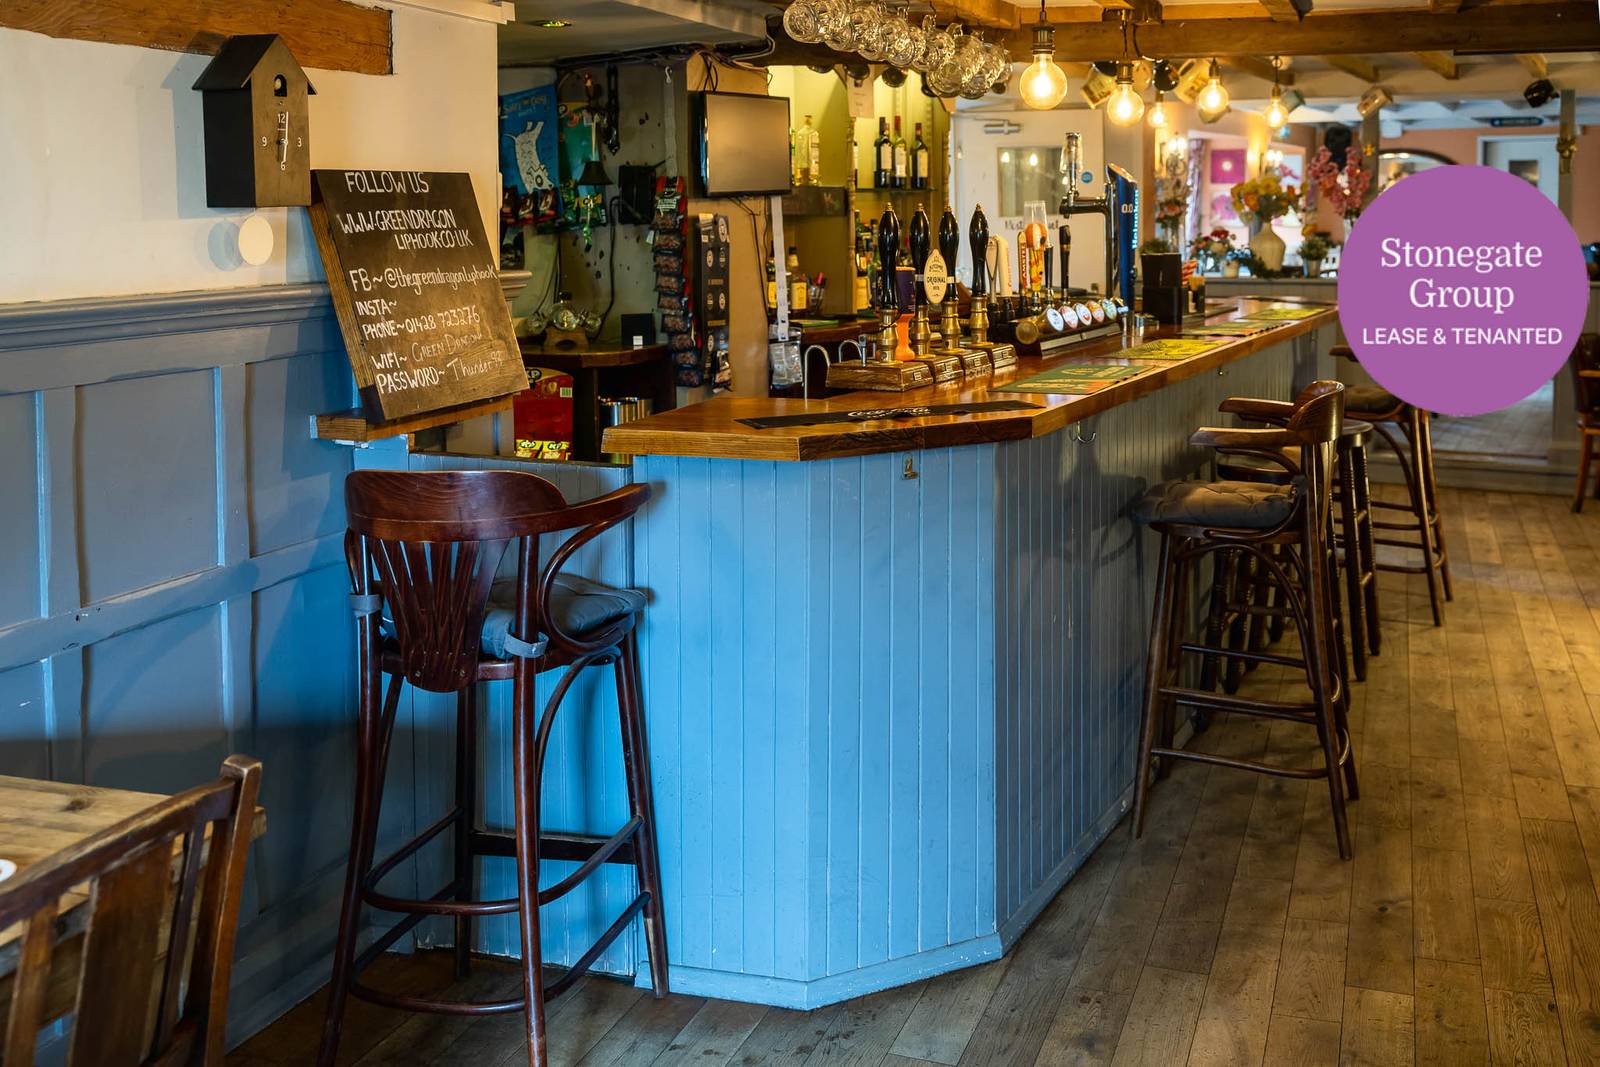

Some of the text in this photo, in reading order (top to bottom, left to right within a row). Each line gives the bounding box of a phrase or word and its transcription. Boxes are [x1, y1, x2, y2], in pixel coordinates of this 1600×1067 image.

[277, 113, 285, 124] 12
[261, 136, 268, 147] 9
[297, 136, 302, 147] 3
[280, 161, 286, 171] 6
[344, 171, 430, 194] FOLLOW US
[437, 305, 481, 327] 723276
